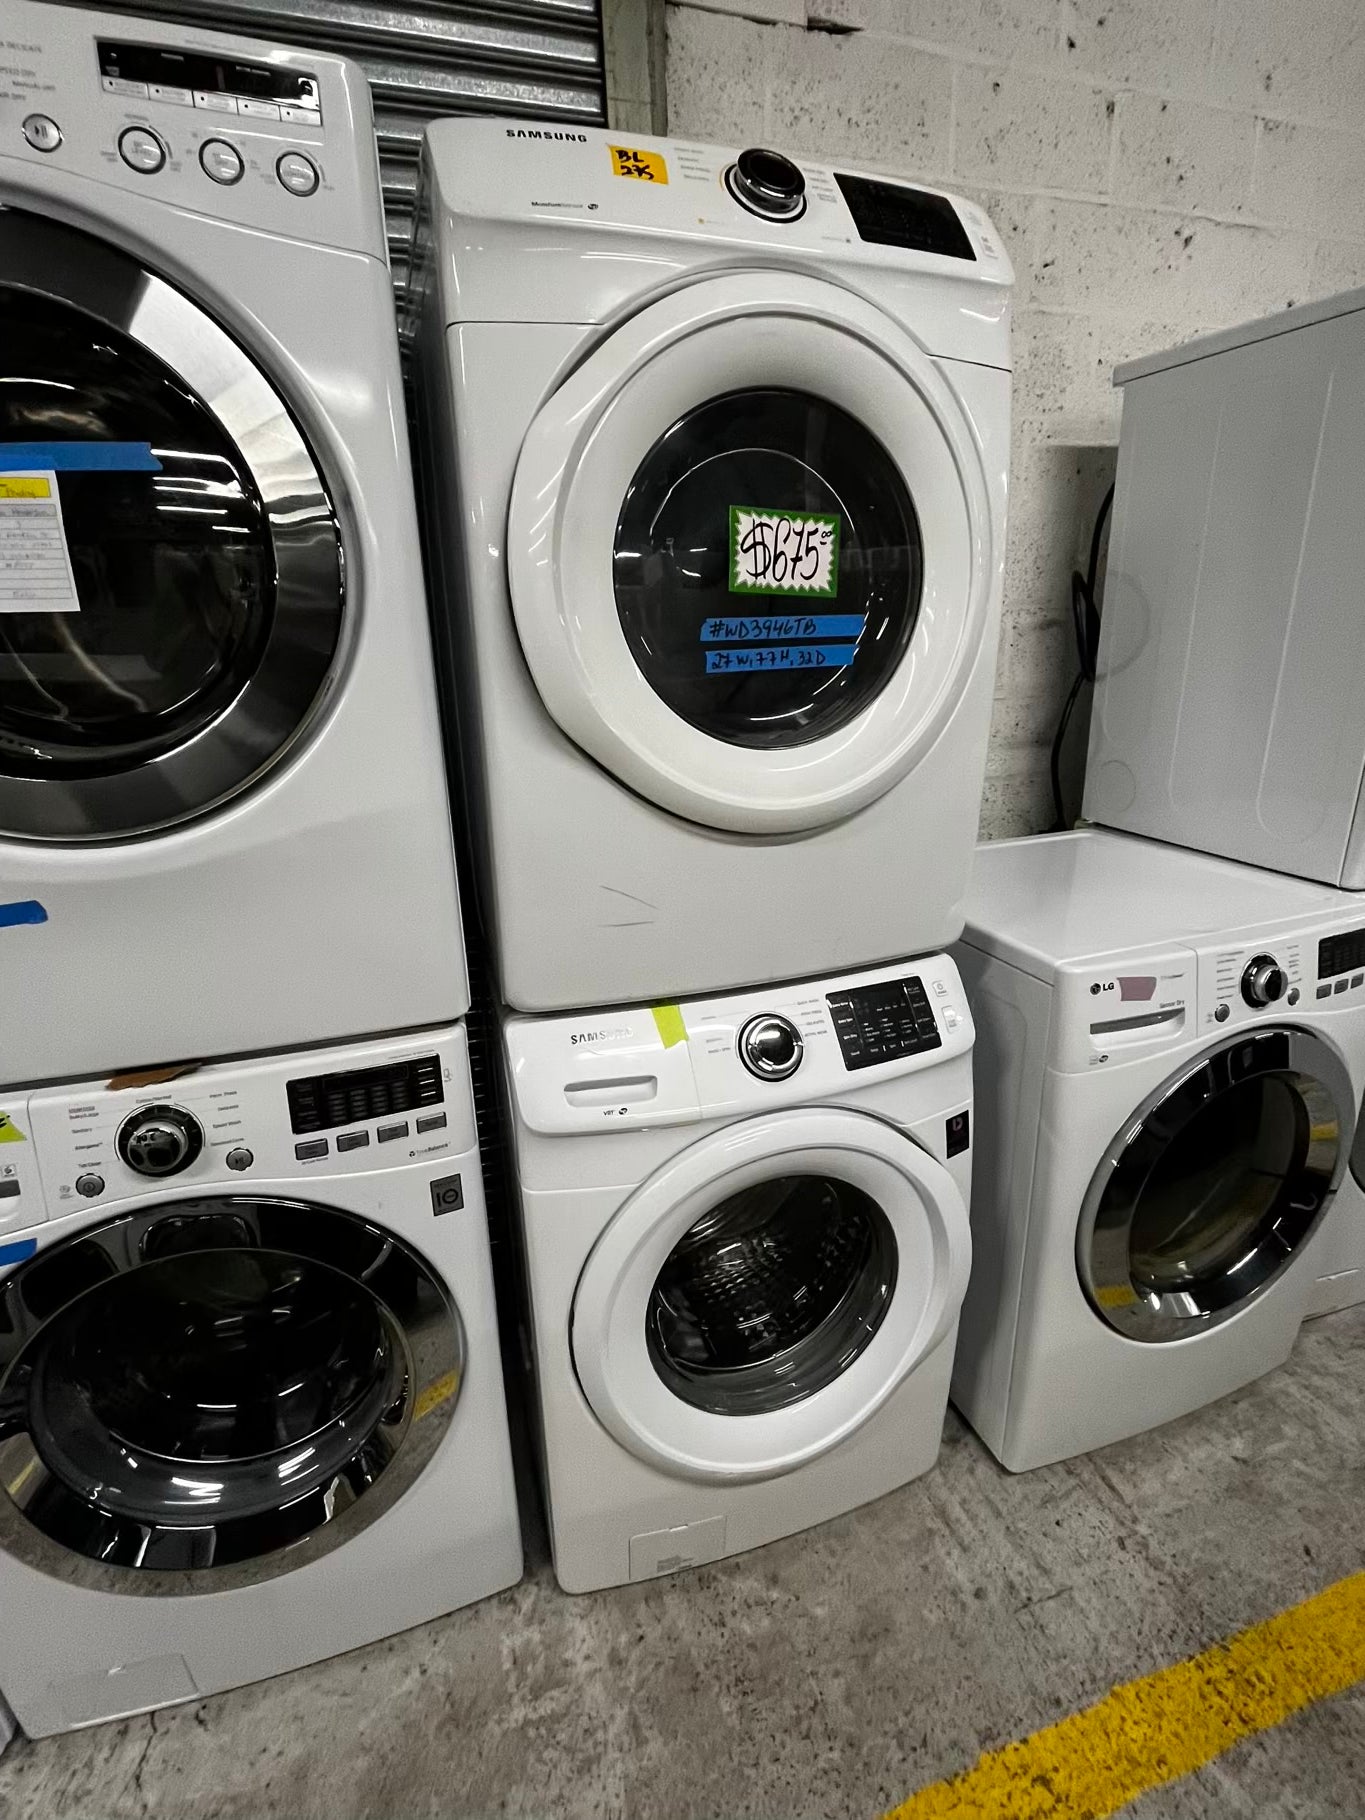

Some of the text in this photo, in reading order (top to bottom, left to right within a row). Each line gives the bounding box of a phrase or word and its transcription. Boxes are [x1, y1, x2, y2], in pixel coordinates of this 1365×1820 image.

[506, 129, 588, 143] SAMSUNG
[615, 149, 645, 164] BL
[709, 617, 818, 639] #WD3946TB
[1102, 981, 1115, 992] LG
